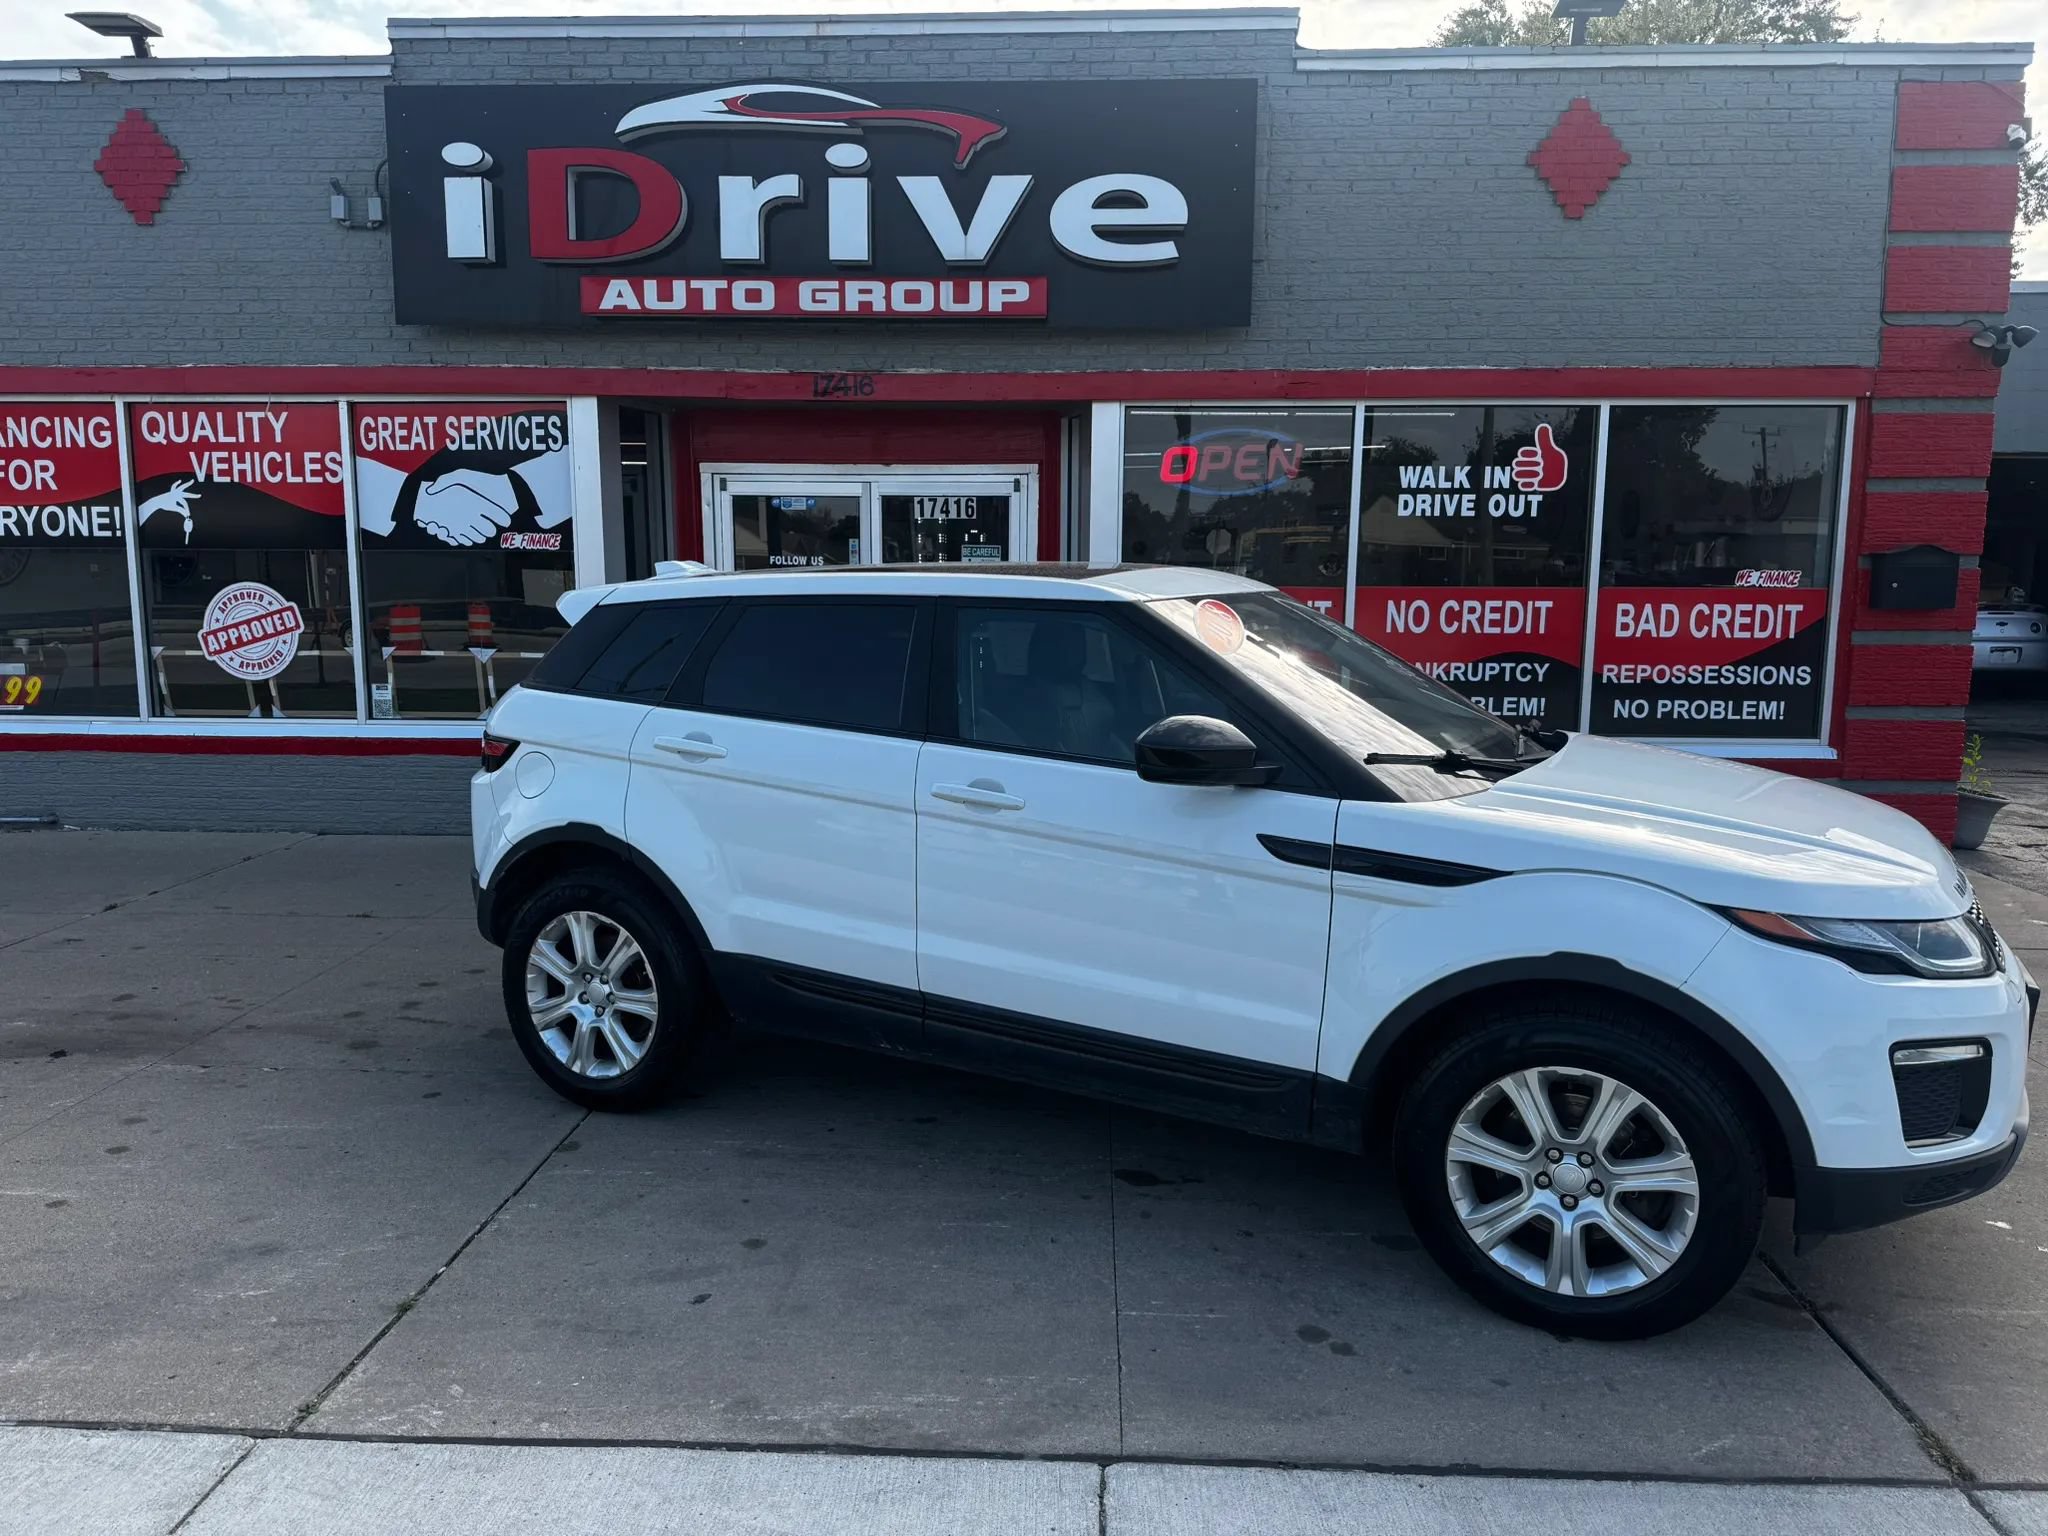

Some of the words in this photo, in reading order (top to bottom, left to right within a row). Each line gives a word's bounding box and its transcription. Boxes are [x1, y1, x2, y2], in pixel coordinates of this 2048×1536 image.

[441, 141, 1188, 266] iDrive
[598, 279, 776, 312] AUTO
[798, 280, 1031, 313] GROUP
[813, 373, 875, 397] 17416
[140, 410, 289, 446] QUALITY
[359, 415, 438, 452] GREAT
[445, 414, 563, 451] SERVICES
[189, 451, 343, 484] VEHICLES
[1159, 443, 1304, 484] OPEN
[1399, 465, 1471, 489] WALK
[1484, 466, 1511, 489] IN
[916, 498, 975, 518] 17416
[1397, 494, 1476, 517] DRIVE
[1488, 494, 1543, 517] OUT
[501, 532, 517, 548] WE
[519, 533, 561, 549] FINANCE
[972, 547, 1000, 556] CAREFUL
[769, 555, 807, 566] FOLLOW
[811, 556, 824, 566] US
[1735, 569, 1754, 586] WE
[1755, 570, 1801, 587] FINANCE
[217, 590, 265, 615] APPROVED
[1386, 600, 1430, 634] NO
[1439, 600, 1553, 634] CREDIT
[1615, 604, 1679, 638] BAD
[1689, 604, 1803, 639] CREDIT
[206, 610, 297, 653] APPROVED
[239, 648, 284, 671] APPROVED
[1602, 664, 1812, 686] REPOSSESSIONS
[1613, 699, 1649, 720] NO
[1656, 700, 1785, 721] PROBLEM!
